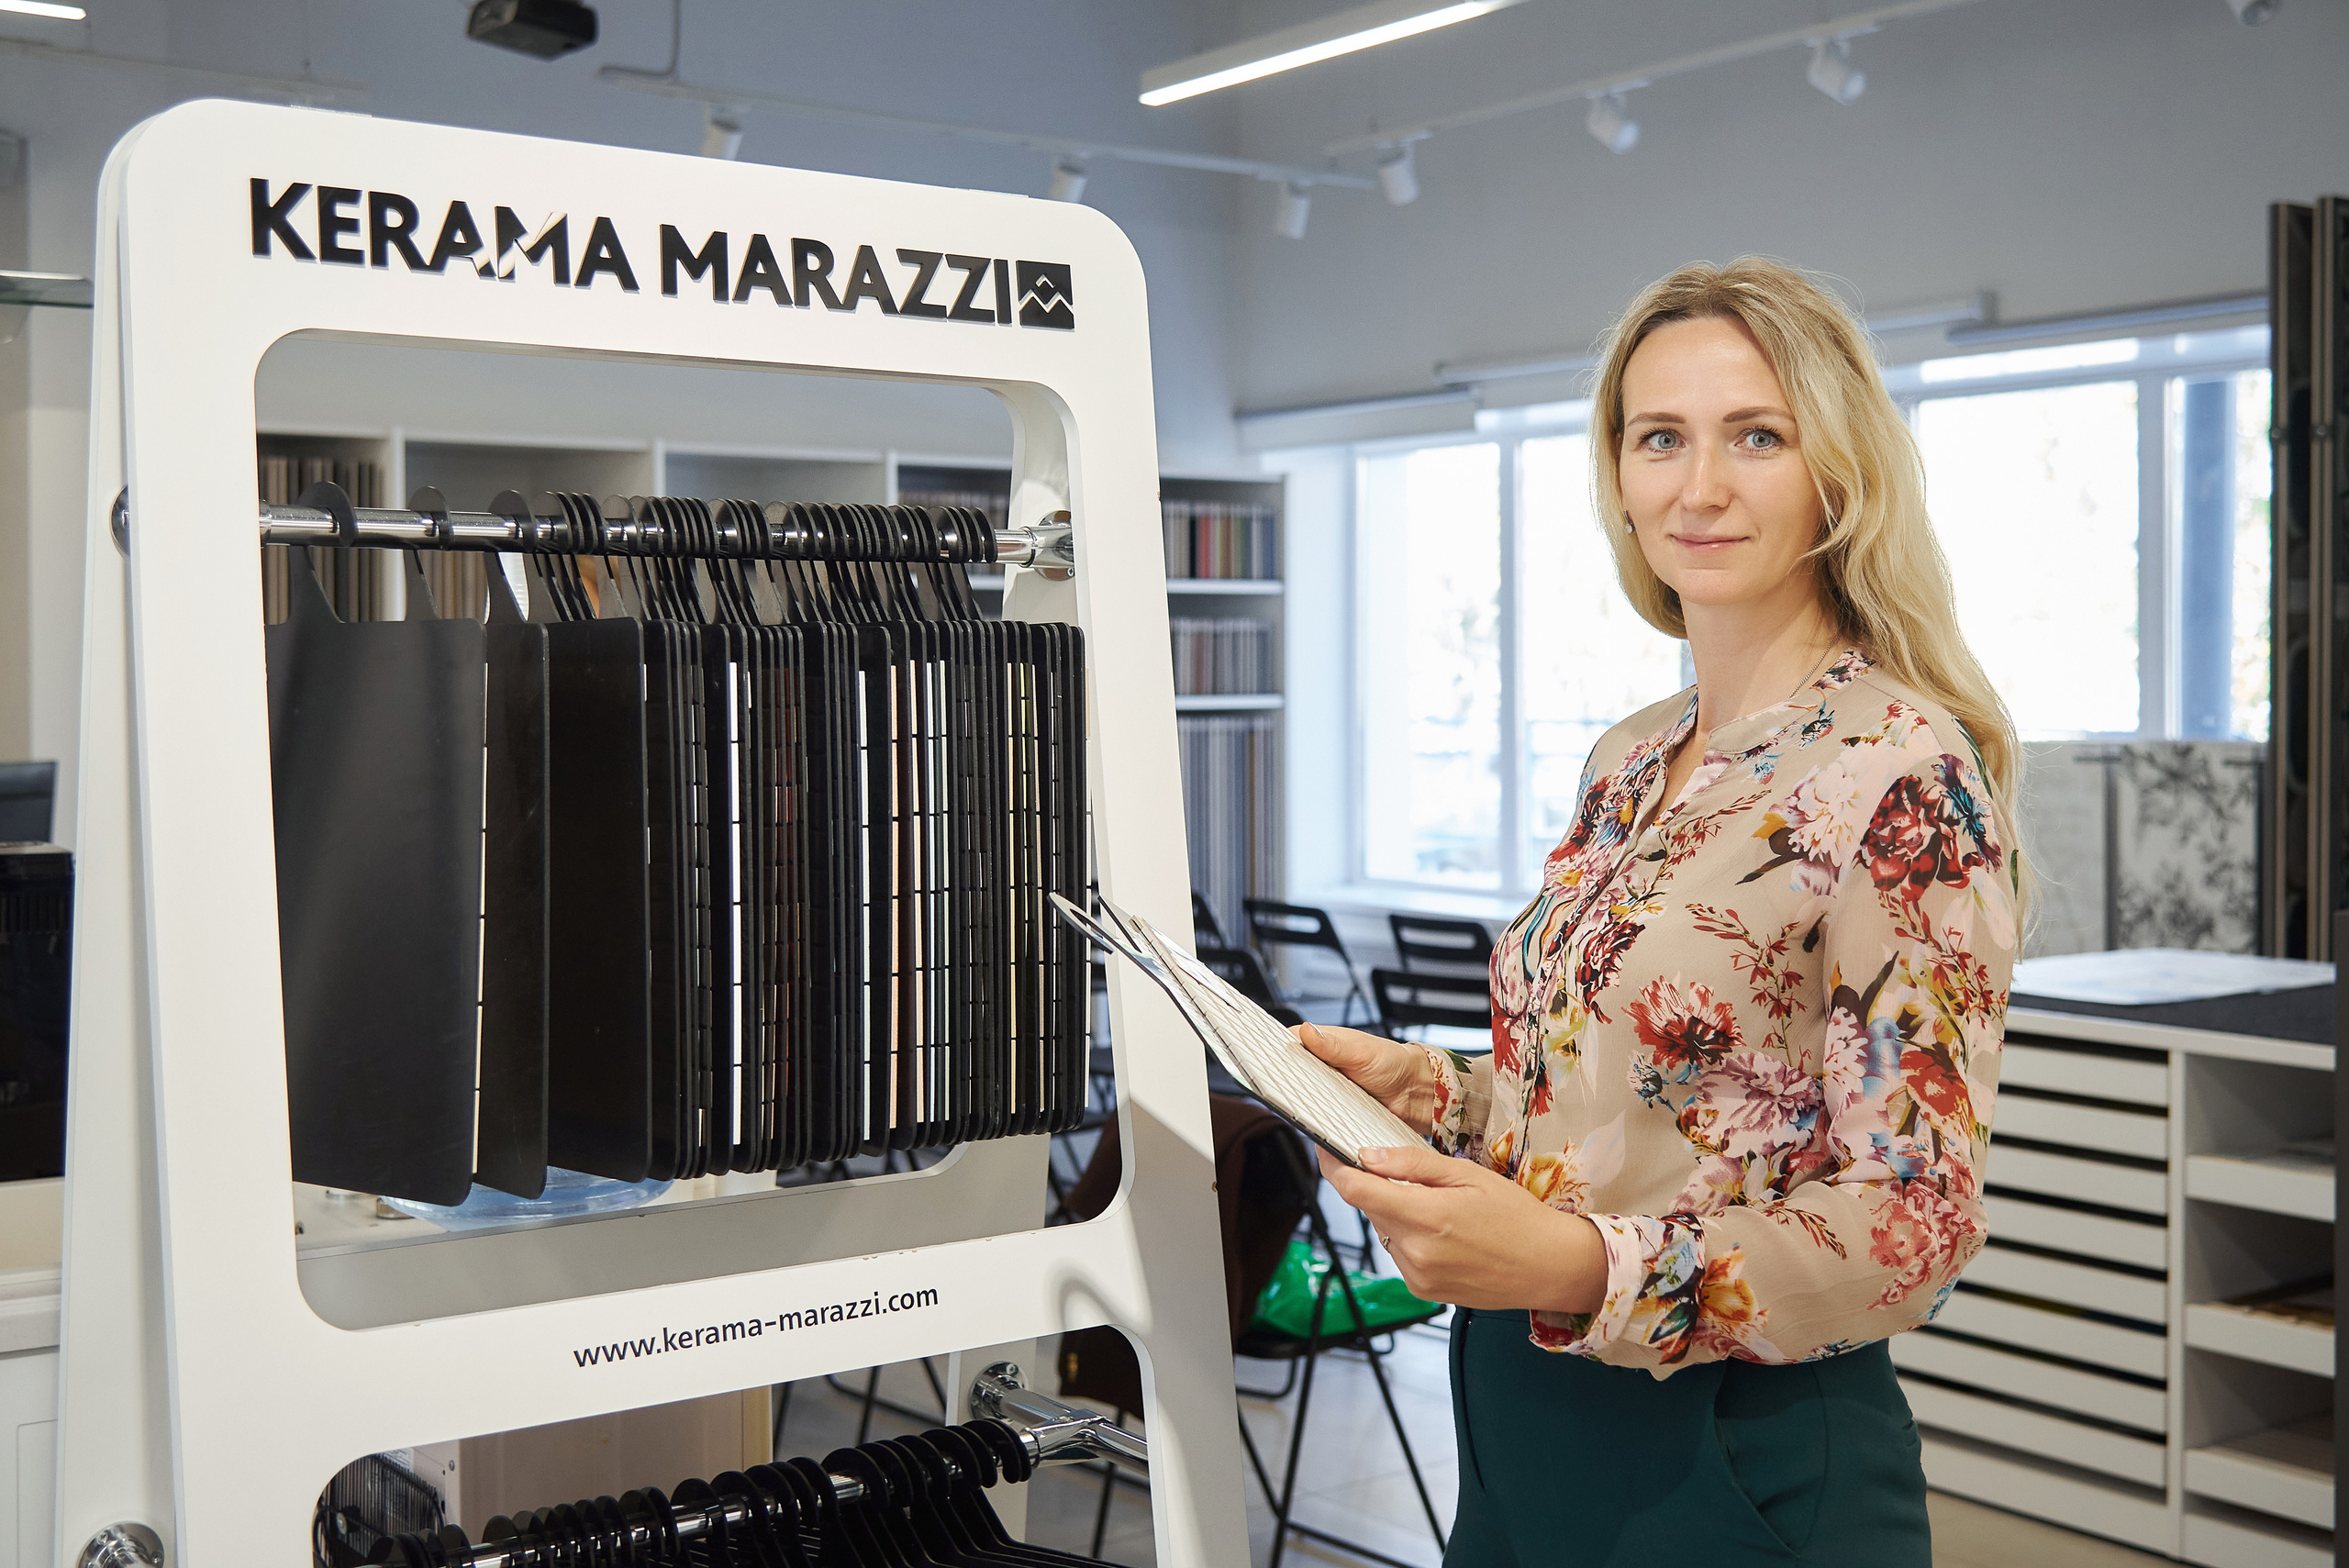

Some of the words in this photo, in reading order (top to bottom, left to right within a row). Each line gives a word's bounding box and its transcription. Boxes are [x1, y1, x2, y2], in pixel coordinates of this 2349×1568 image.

[249, 177, 640, 292] KERAMA
[660, 223, 1011, 325] MARAZZI
[573, 1287, 939, 1368] www.kerama-marazzi.com
